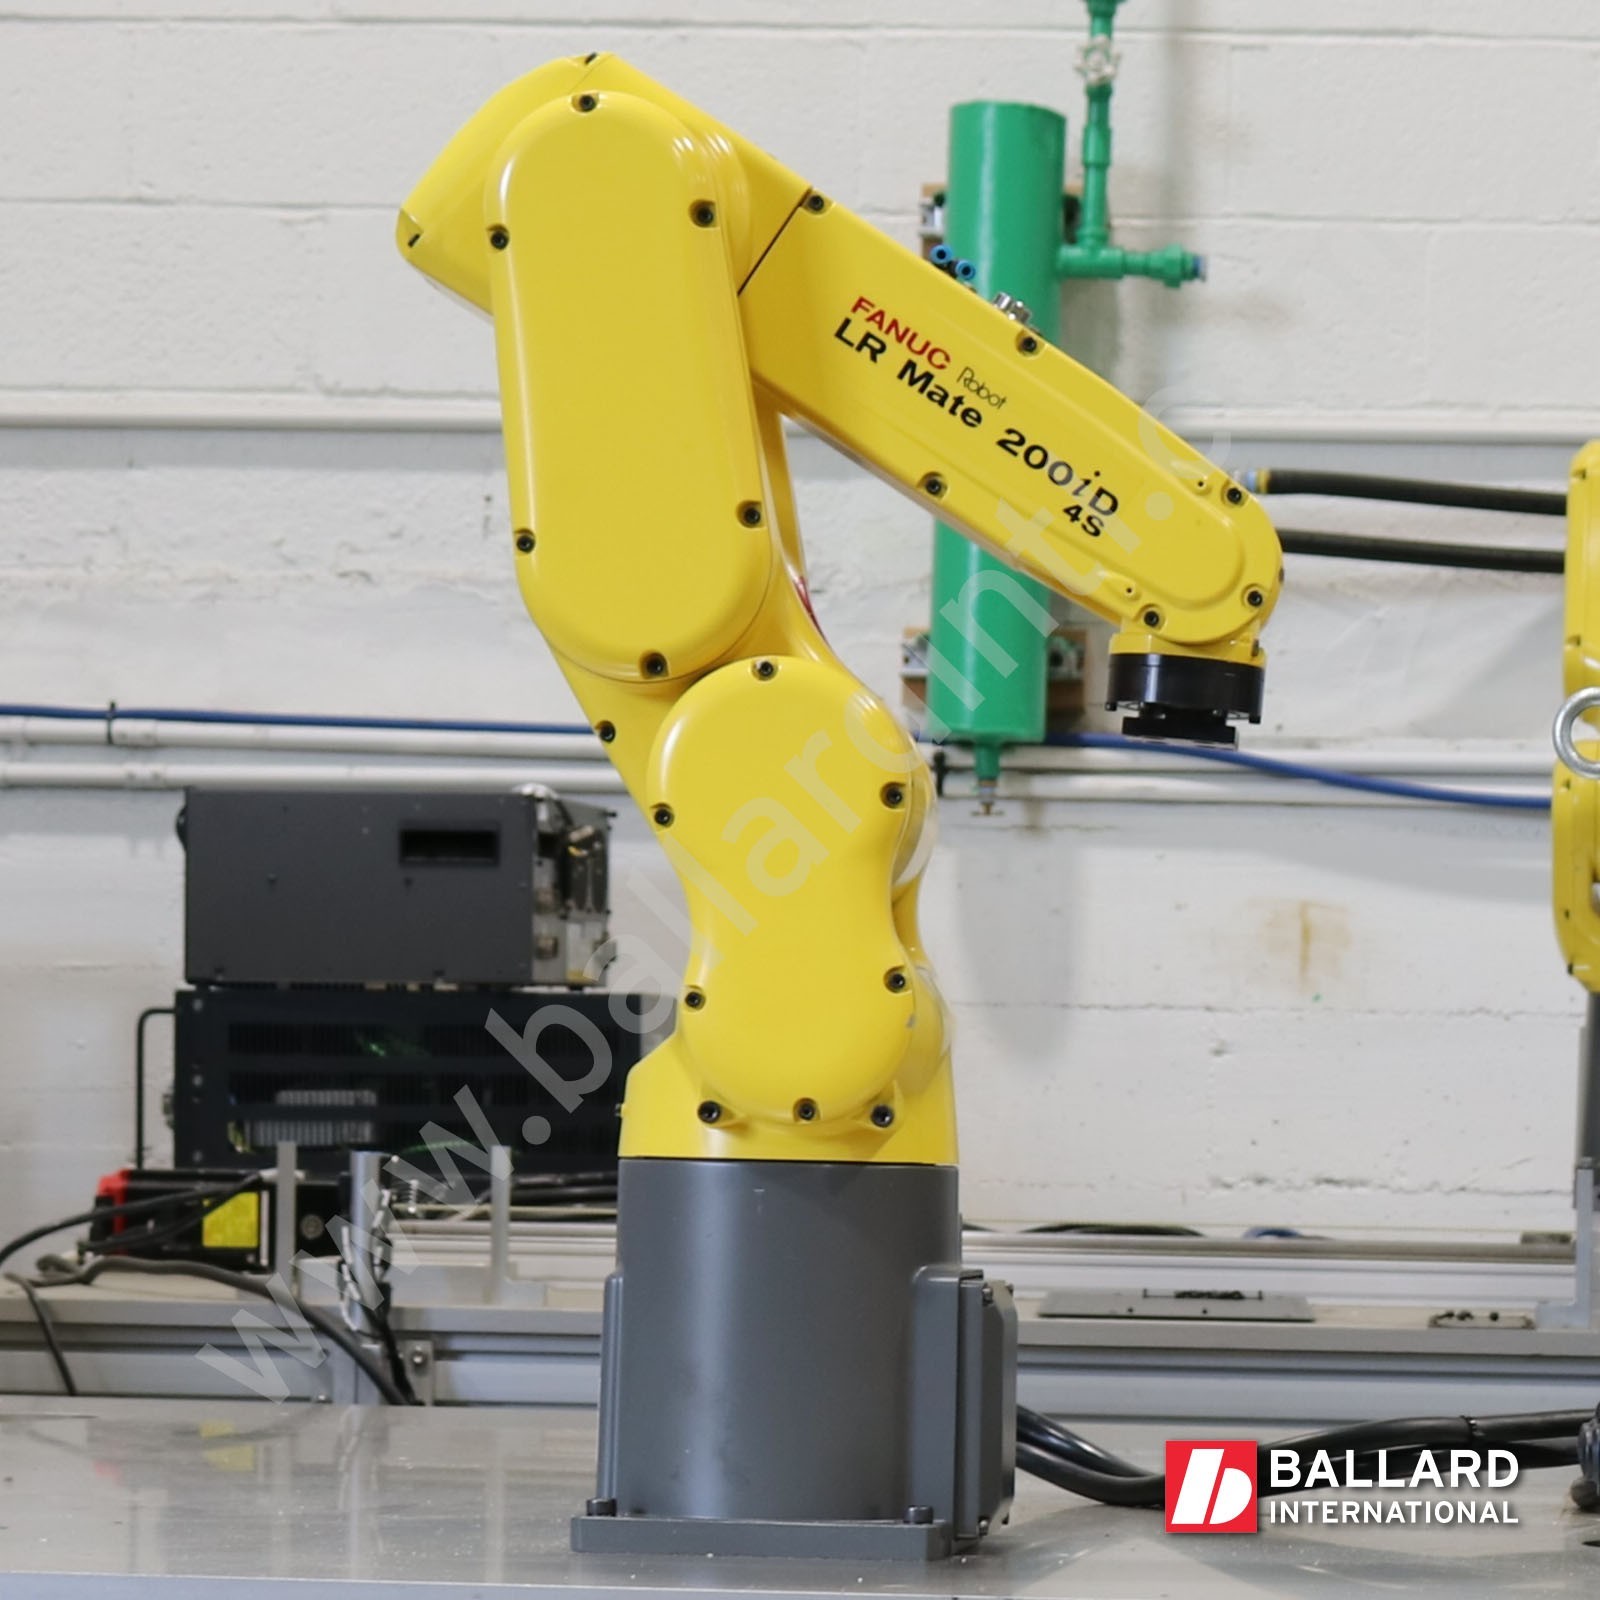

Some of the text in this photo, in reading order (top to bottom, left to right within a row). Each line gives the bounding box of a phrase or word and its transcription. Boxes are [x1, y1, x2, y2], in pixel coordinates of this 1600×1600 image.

[850, 295, 1007, 410] FANUC Robot
[833, 316, 1119, 516] LR Mate 200iD
[1062, 504, 1105, 538] 4S
